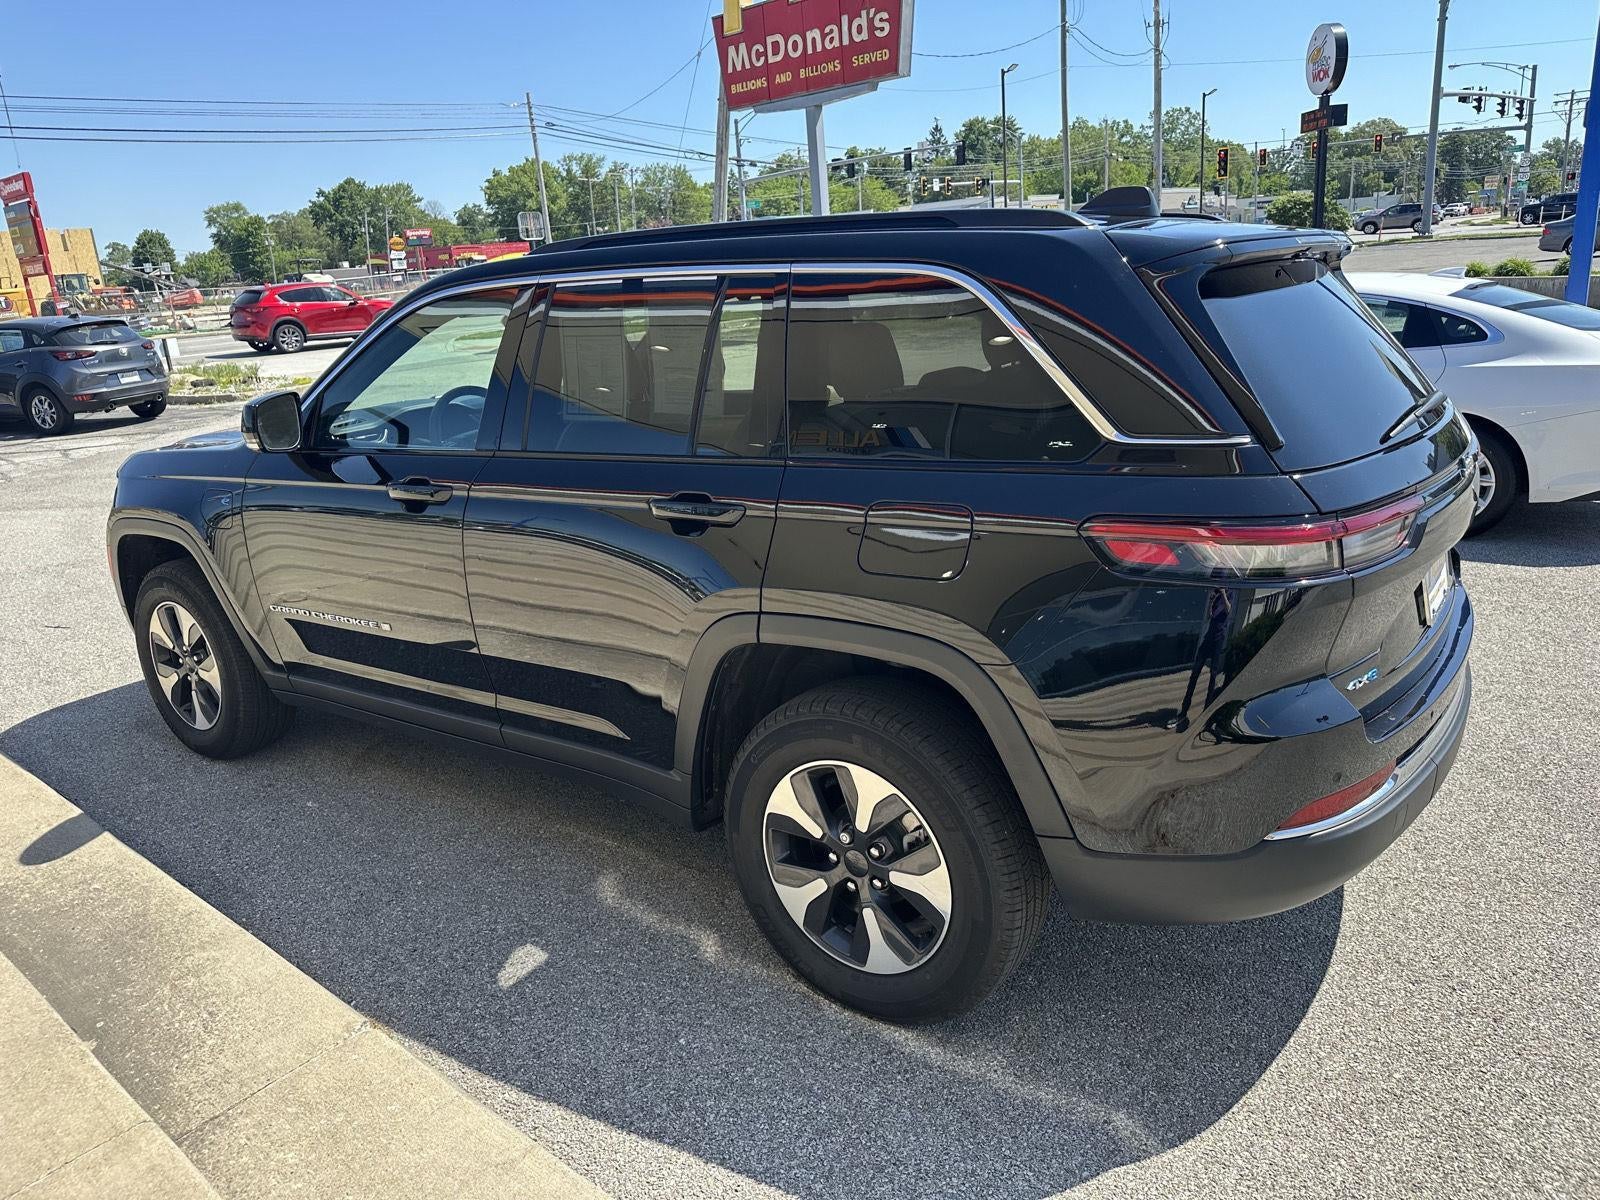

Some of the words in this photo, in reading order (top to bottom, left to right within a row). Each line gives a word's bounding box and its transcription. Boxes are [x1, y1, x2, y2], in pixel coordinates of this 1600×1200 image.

[727, 8, 890, 74] McDonald's
[730, 77, 767, 94] BILLIONS
[775, 71, 792, 84] AND
[799, 60, 841, 79] BILLIONS
[851, 49, 889, 67] SERVED
[269, 604, 310, 617] GRAND
[310, 610, 380, 629] CHEROKEE
